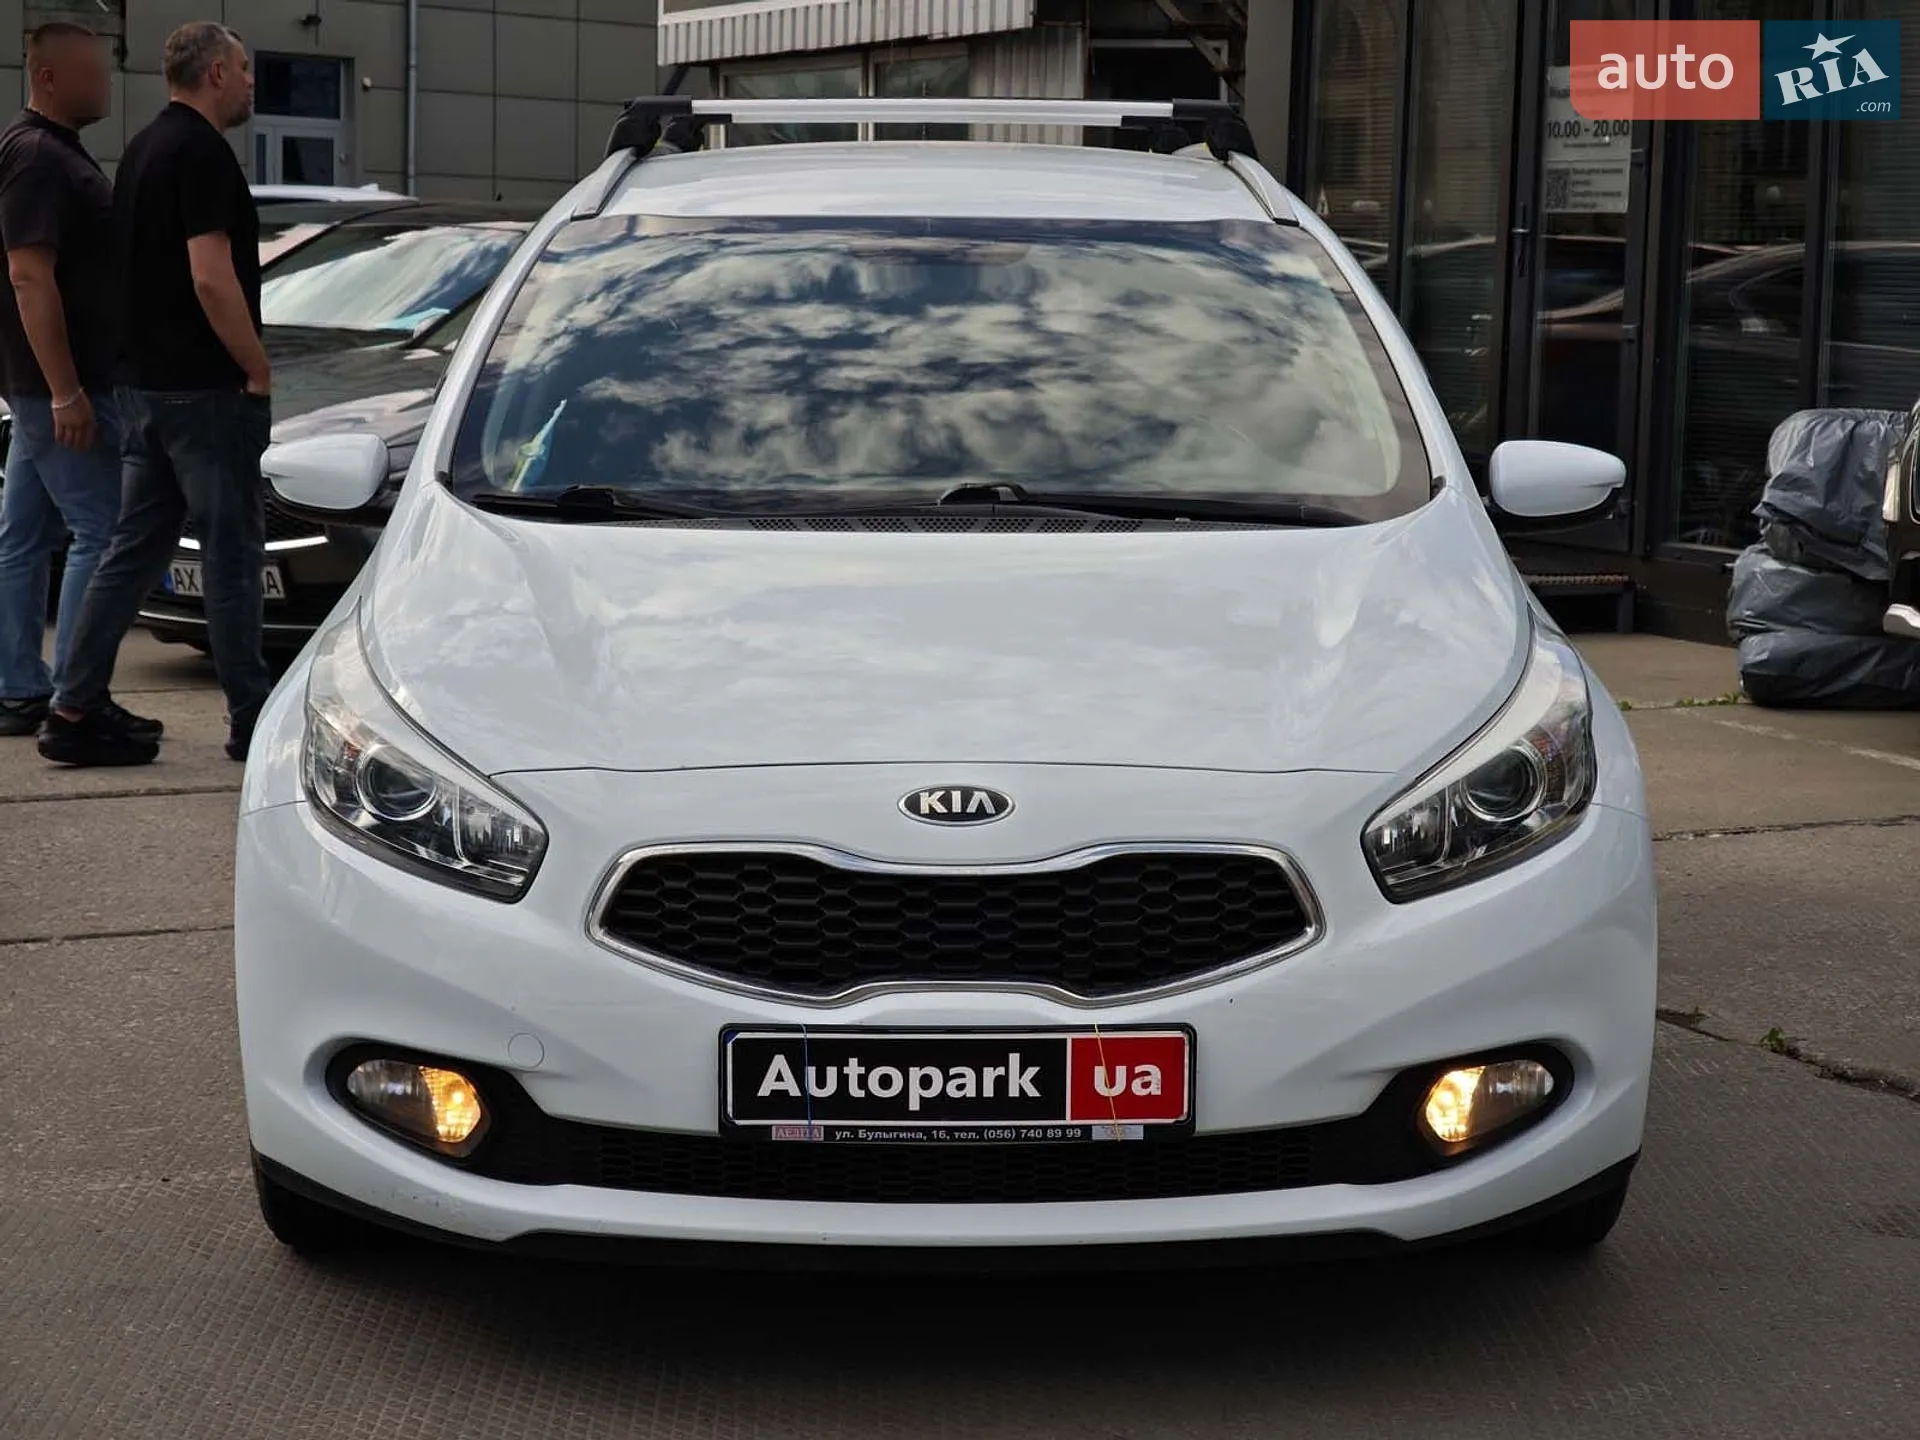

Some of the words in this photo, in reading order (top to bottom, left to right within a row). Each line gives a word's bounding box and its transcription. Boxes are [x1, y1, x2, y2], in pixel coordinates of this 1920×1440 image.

[1547, 120, 1581, 138] 10.00
[173, 567, 200, 592] AX
[919, 790, 996, 814] KIA
[757, 1052, 1041, 1110] Autopark
[1093, 1064, 1161, 1096] ua
[835, 1130, 854, 1140] ул.
[954, 1131, 980, 1139] тел.
[983, 1127, 1016, 1140] (056)
[1020, 1128, 1042, 1138] 740
[1065, 1128, 1082, 1138] 99
